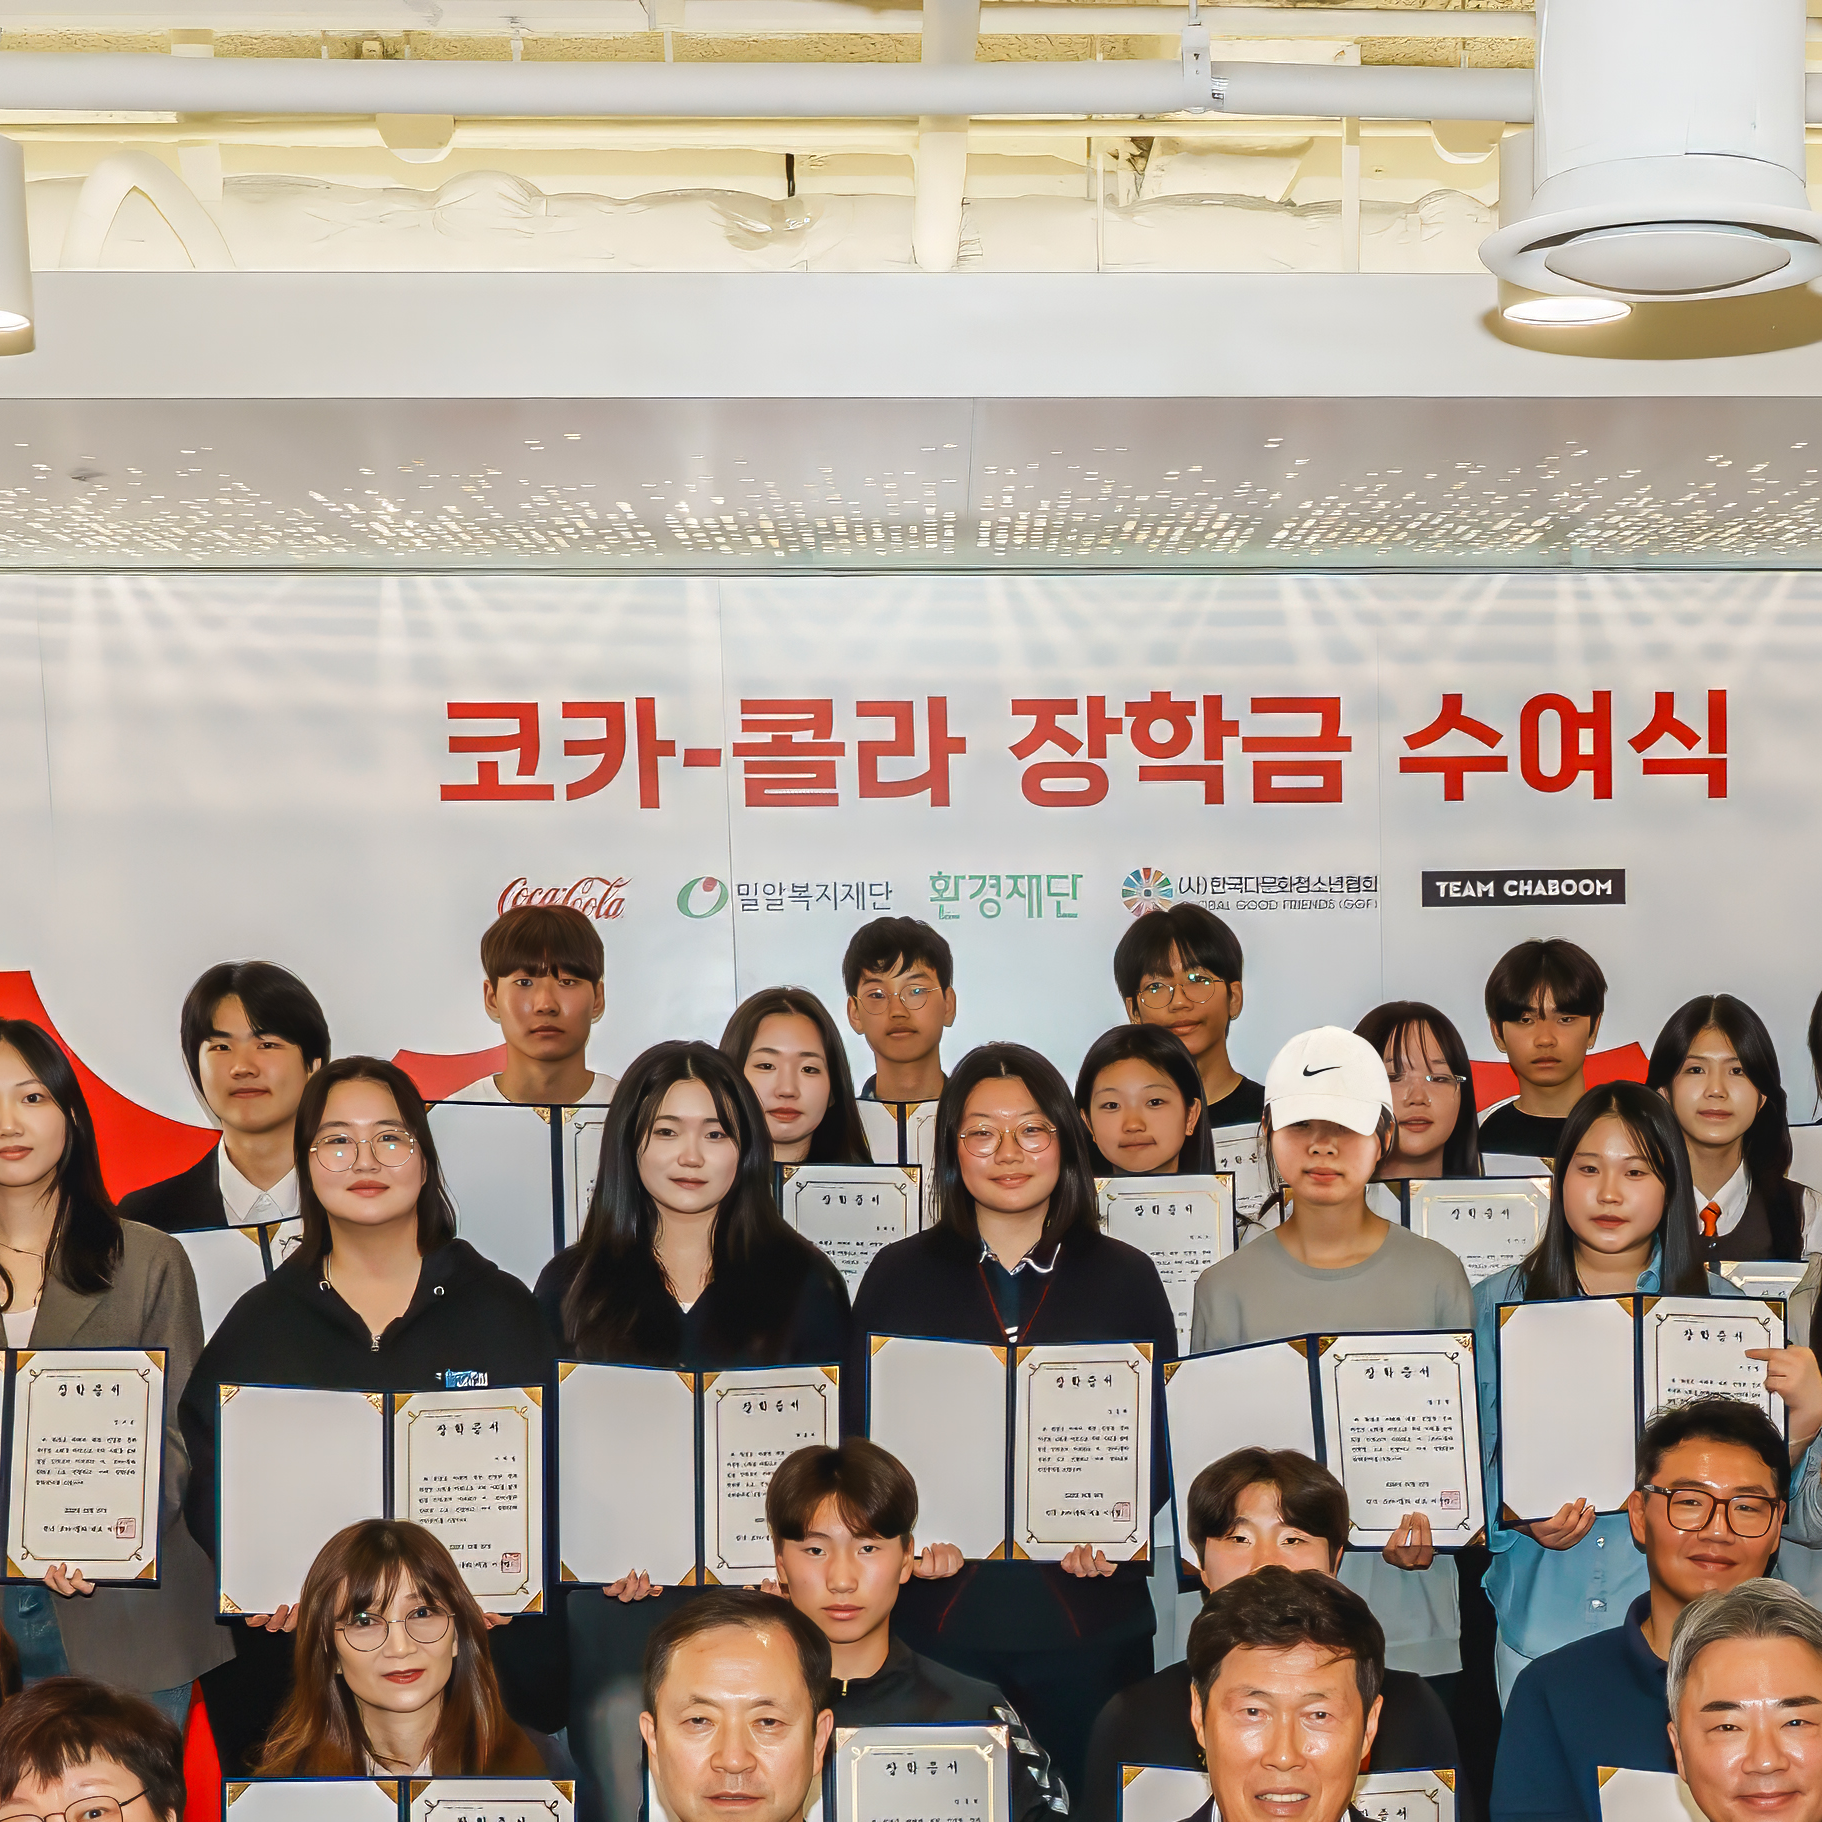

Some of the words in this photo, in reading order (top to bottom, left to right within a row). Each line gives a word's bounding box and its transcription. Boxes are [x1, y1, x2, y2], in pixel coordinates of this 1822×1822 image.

[439, 695, 967, 810] 코카-콜라
[1008, 690, 1352, 808] 장학금
[1398, 689, 1728, 802] 수여식
[498, 876, 632, 920] Coca-Cola
[736, 881, 893, 912] 밀알복지재단
[928, 871, 1083, 919] 환경재단
[1435, 880, 1496, 898] TEAM
[1502, 878, 1613, 897] CHABOOM
